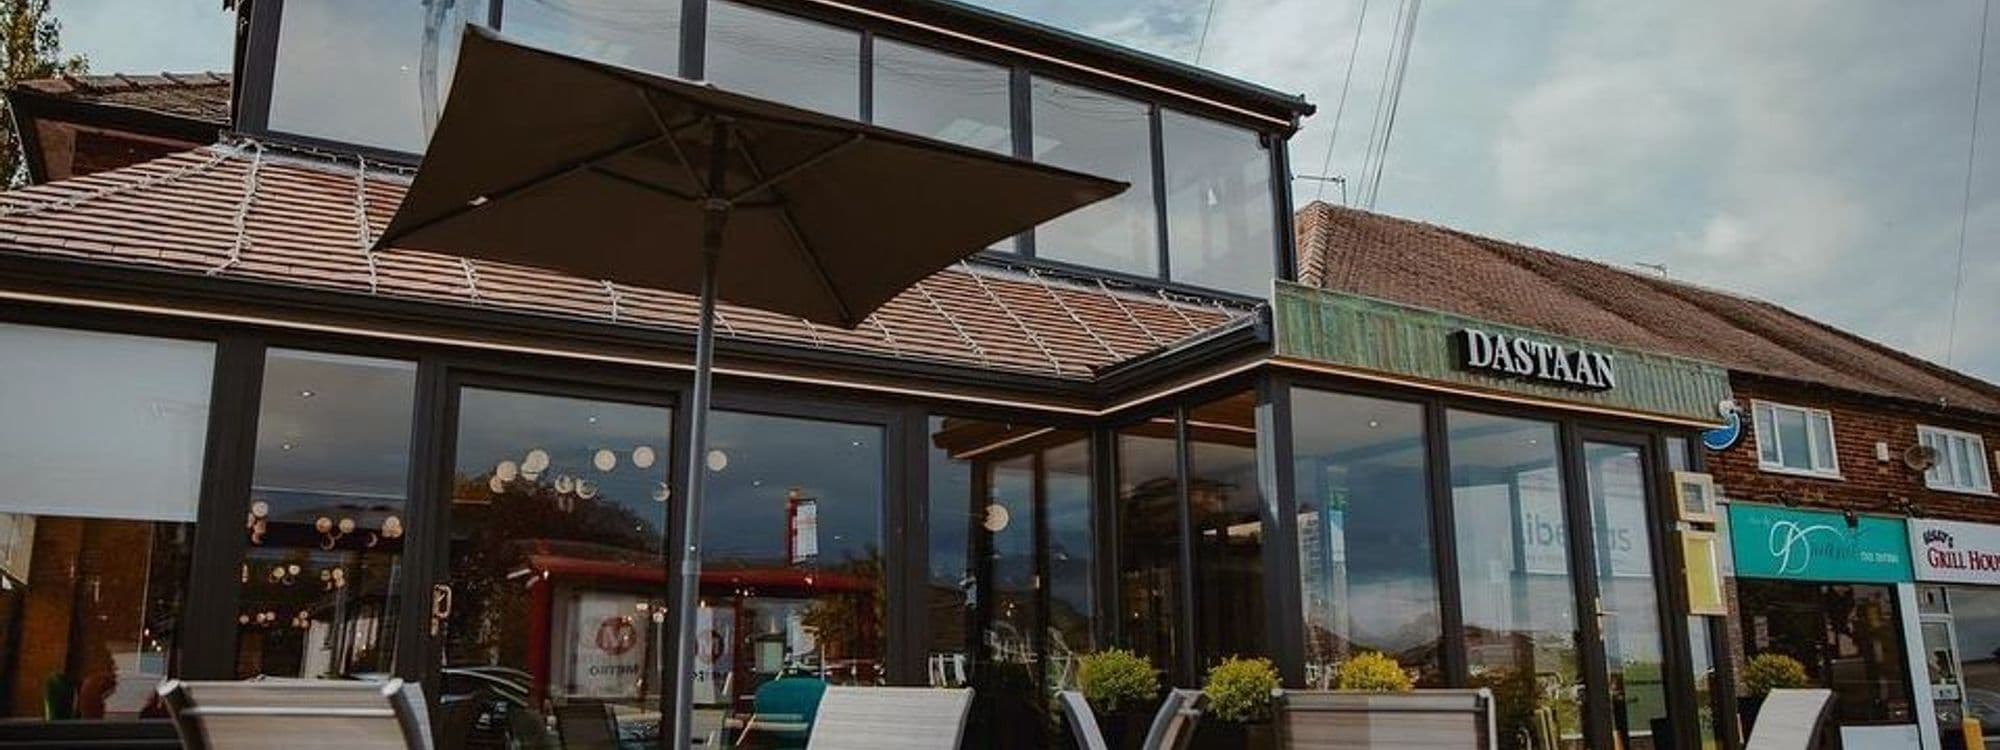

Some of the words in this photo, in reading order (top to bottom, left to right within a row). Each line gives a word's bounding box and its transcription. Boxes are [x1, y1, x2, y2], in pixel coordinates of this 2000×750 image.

[1464, 328, 1615, 388] DASTAAN
[1927, 547, 1967, 569] GRILL
[1968, 550, 2000, 571] HOU
